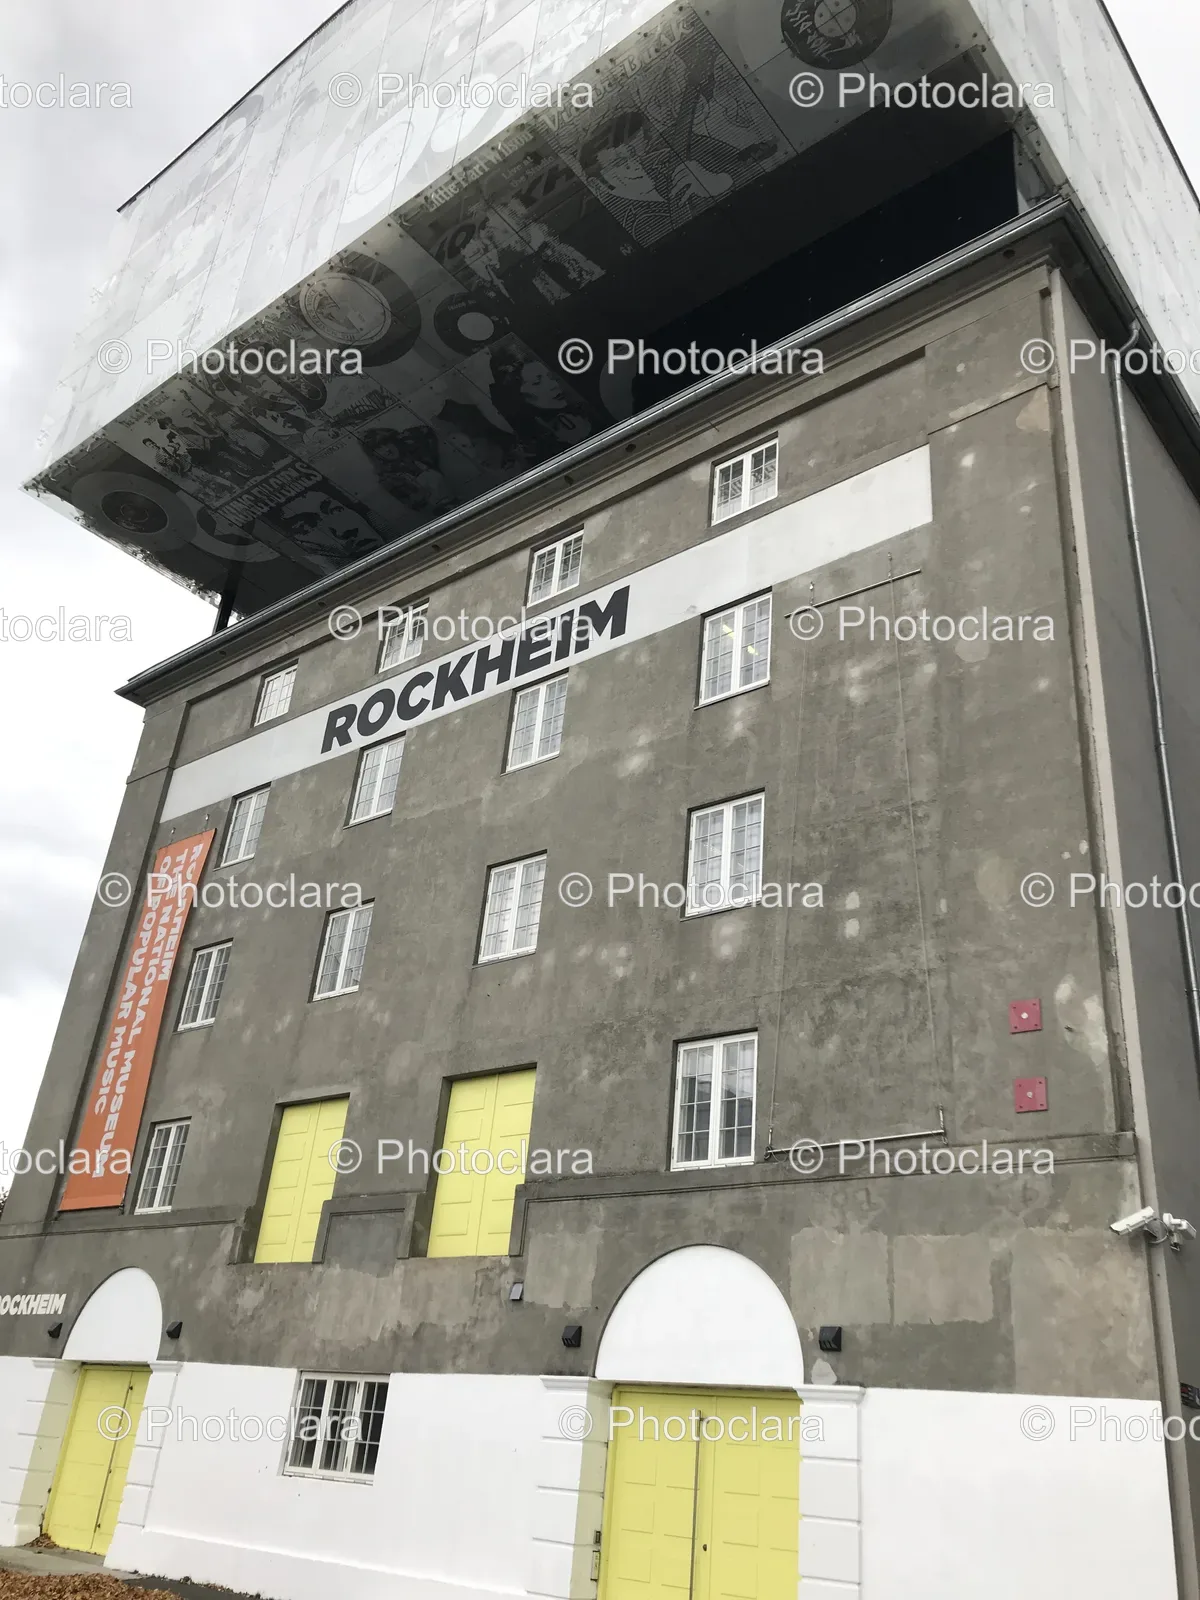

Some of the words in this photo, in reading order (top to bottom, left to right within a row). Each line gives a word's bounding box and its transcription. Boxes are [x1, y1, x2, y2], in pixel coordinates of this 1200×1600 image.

[320, 585, 630, 755] ROCKHEIM
[116, 894, 161, 1020] POPULAR
[128, 904, 173, 1045] NATIONAL
[92, 1050, 136, 1178] MUSEUM
[94, 1025, 127, 1116] MUSIC
[0, 1293, 67, 1316] OCKHEIM
